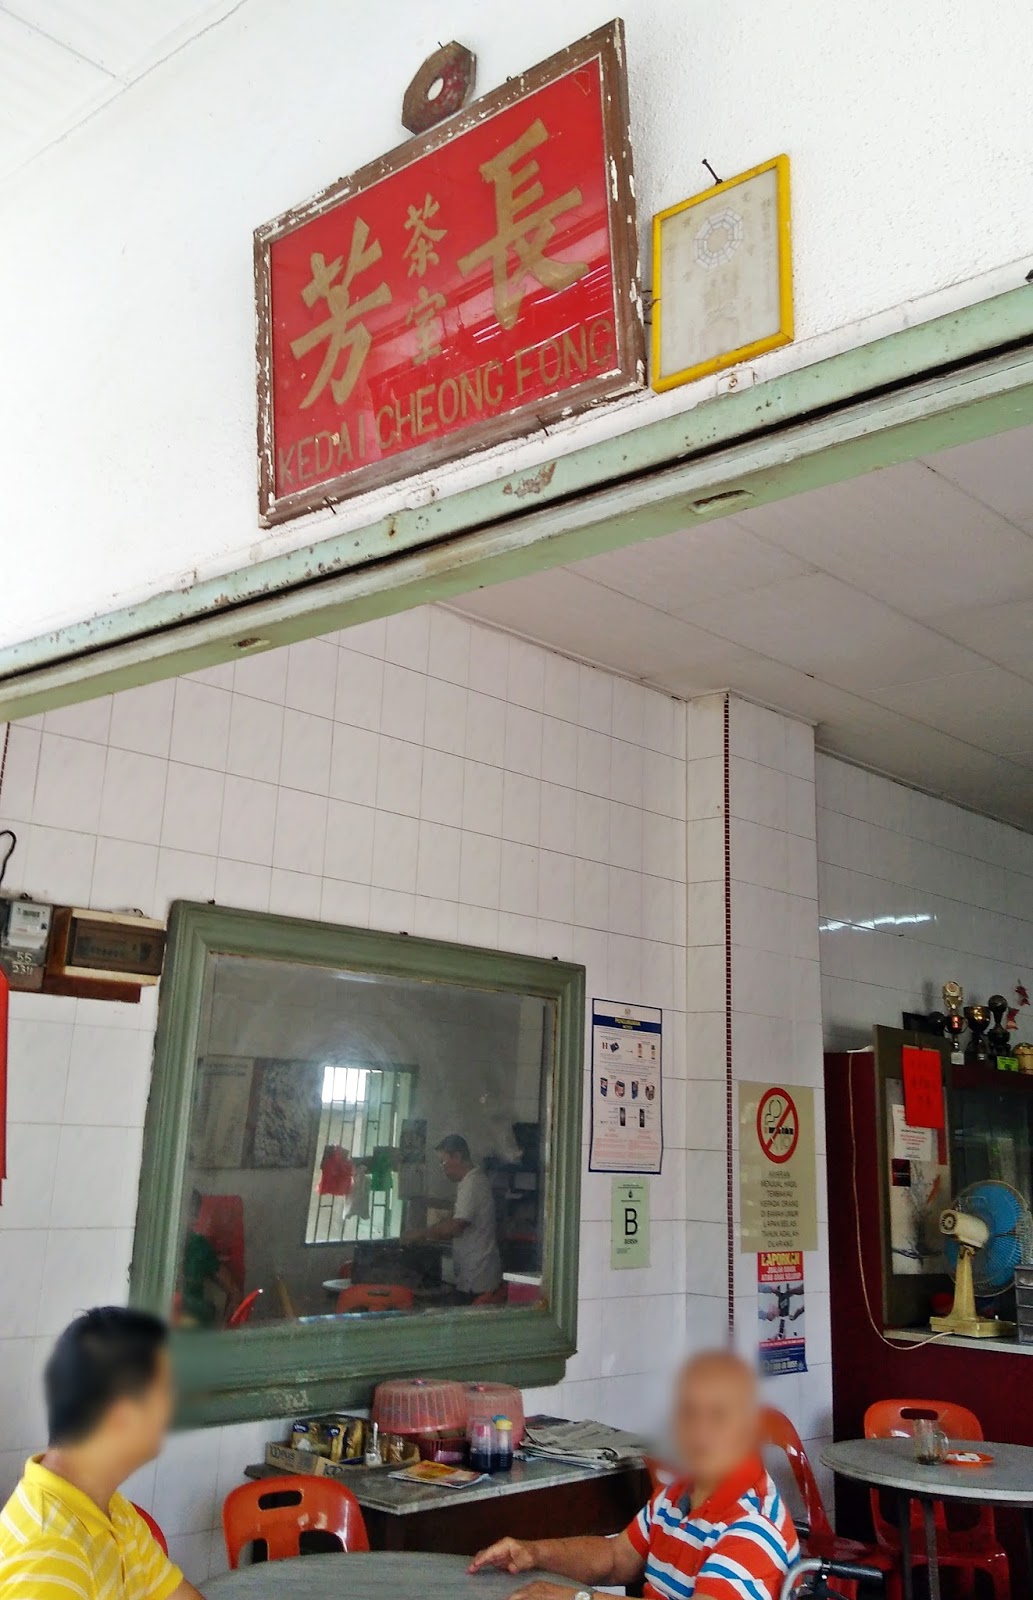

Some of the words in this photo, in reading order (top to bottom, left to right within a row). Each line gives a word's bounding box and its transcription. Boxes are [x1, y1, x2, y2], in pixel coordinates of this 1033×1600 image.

[402, 193, 448, 366] 茶室
[456, 119, 590, 330] 長
[290, 217, 391, 410] 芳
[278, 414, 364, 489] KEDAI
[375, 359, 504, 450] CHEONG
[515, 319, 613, 397] FONG
[624, 1207, 638, 1236] B
